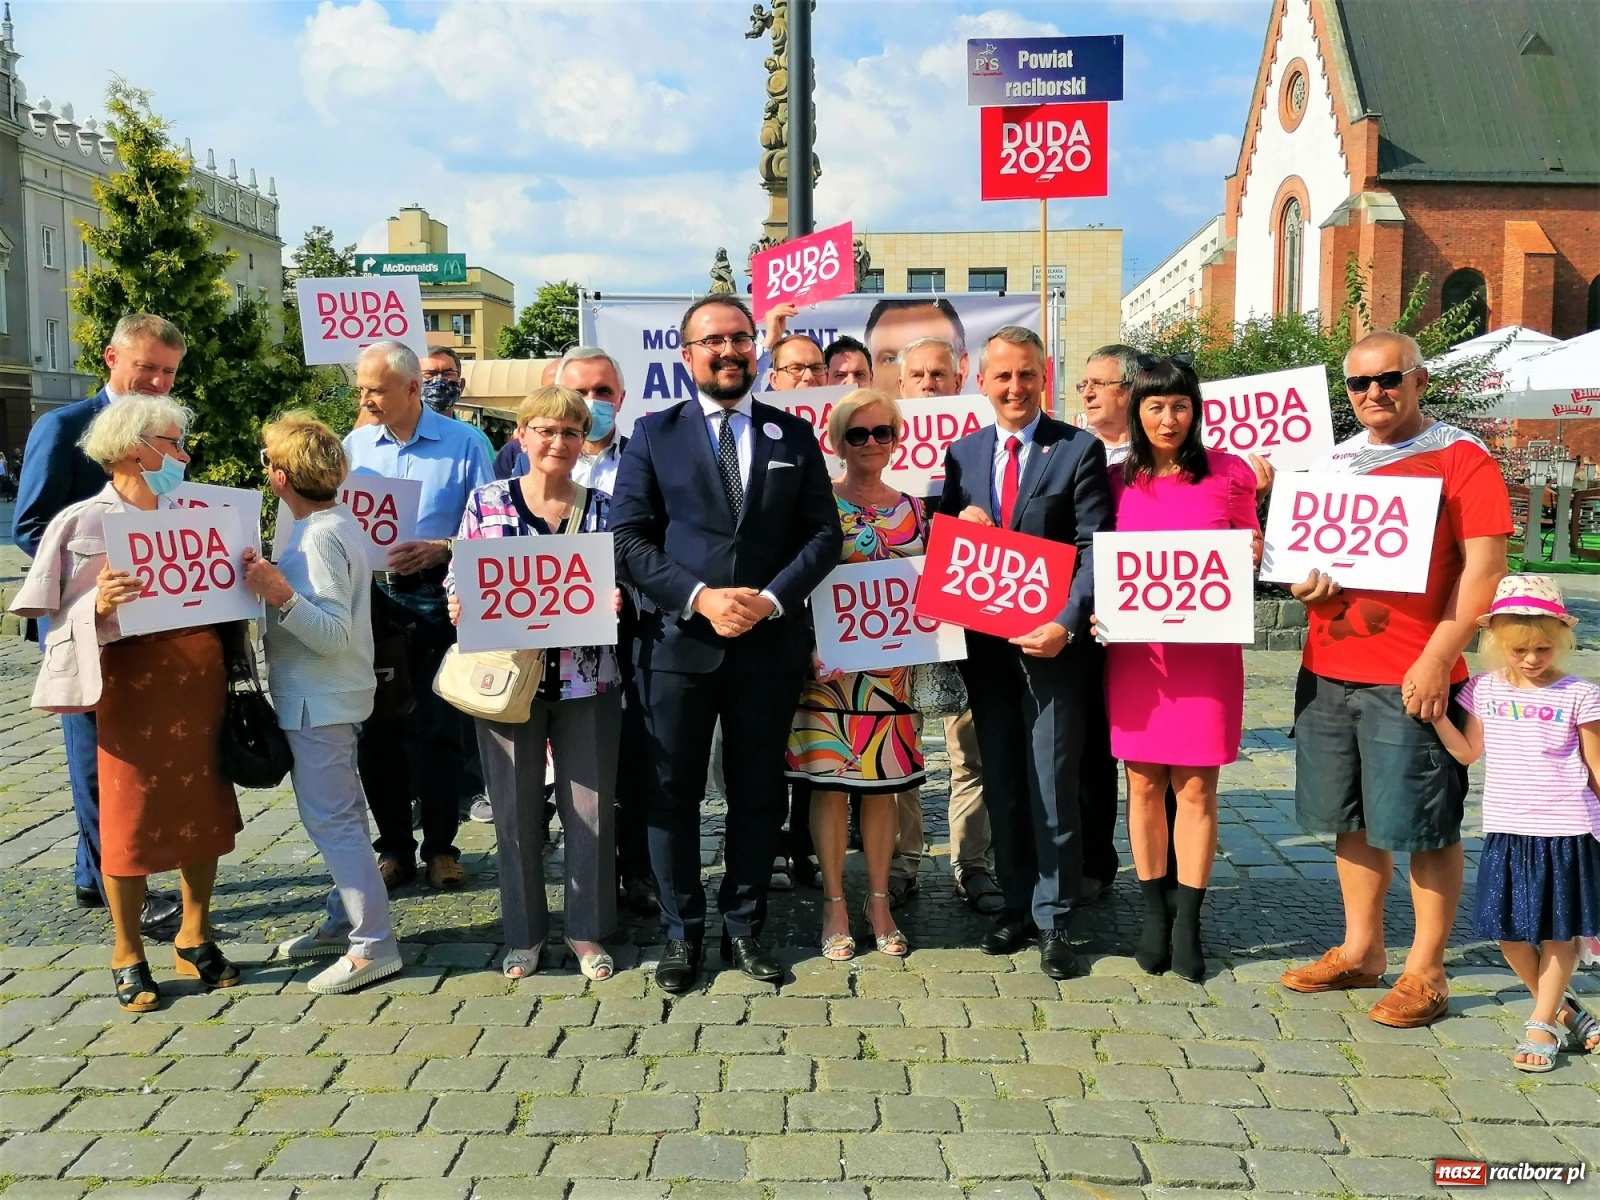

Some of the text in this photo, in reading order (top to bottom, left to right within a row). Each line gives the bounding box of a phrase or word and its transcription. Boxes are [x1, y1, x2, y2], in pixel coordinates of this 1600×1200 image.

[1018, 49, 1073, 69] Powiat
[1005, 76, 1086, 98] raciborski
[1002, 120, 1091, 148] DUDA
[1000, 145, 1092, 174] 2020
[382, 263, 439, 273] McDonald's
[768, 240, 839, 280] DUDA
[766, 258, 840, 300] 2020
[316, 290, 405, 316] DUDA
[321, 314, 409, 340] 2020
[1203, 387, 1308, 427] DUDA
[1207, 415, 1311, 453] 2020
[1292, 491, 1409, 527] DUDA
[128, 527, 230, 565] DUDA
[1287, 522, 1408, 558] 2020
[136, 558, 236, 599] 2020
[477, 553, 592, 589] DUDA
[951, 537, 1050, 588] DUDA
[1117, 550, 1229, 581] DUDA
[481, 584, 595, 620] 2020
[832, 575, 921, 613] DUD
[941, 564, 1048, 614] 2020
[1118, 581, 1231, 611] 2020
